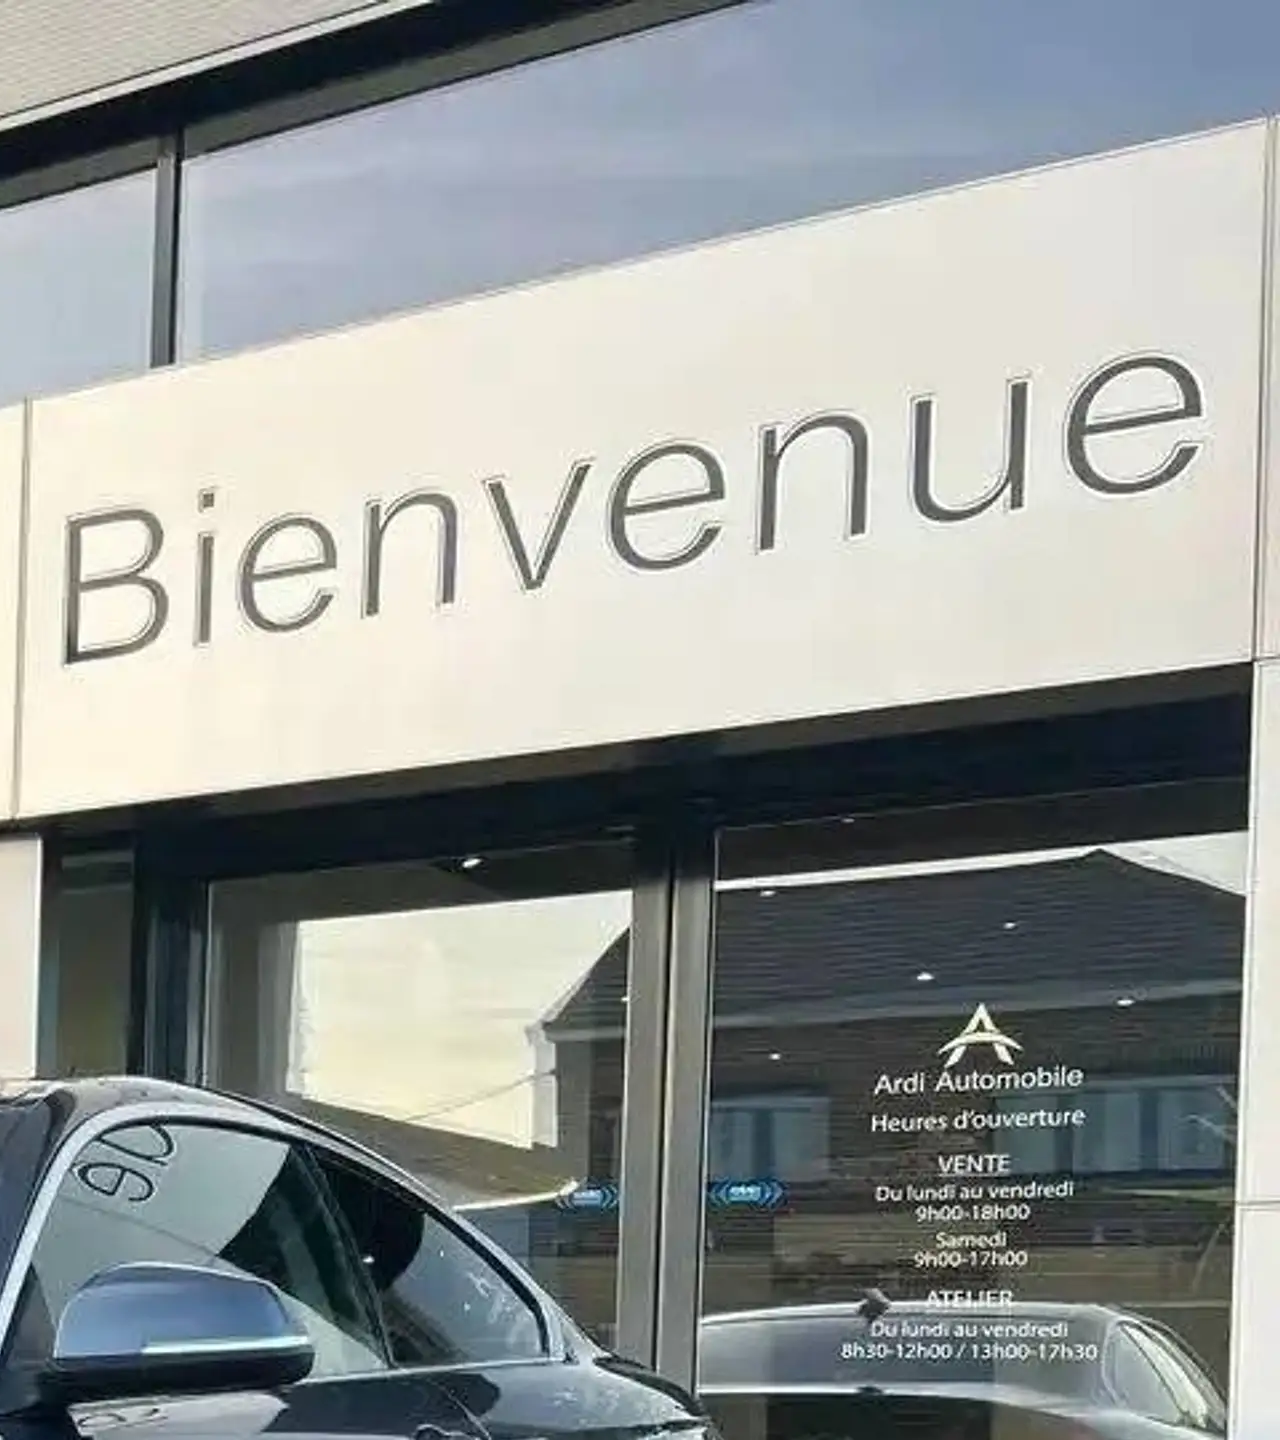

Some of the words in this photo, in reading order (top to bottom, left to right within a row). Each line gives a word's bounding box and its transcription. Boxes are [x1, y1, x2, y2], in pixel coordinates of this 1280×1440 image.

[62, 350, 1203, 664] Bienvenue
[874, 1072, 925, 1096] Ardi
[934, 1065, 1085, 1092] Automobile
[871, 1113, 947, 1132] Heures
[953, 1108, 1087, 1129] d'ouverture
[938, 1153, 1011, 1174] VENTE
[875, 1186, 903, 1201] Du
[906, 1183, 955, 1200] lundi
[959, 1186, 983, 1199] au
[988, 1181, 1074, 1198] vendredi
[915, 1204, 1031, 1221] 9h00-18h00
[935, 1231, 1007, 1248] Samedi
[914, 1250, 1028, 1268] 9h00-17h00
[926, 1289, 1013, 1308] ATELIER
[870, 1323, 896, 1338] Du
[901, 1321, 949, 1338] lundi
[953, 1324, 978, 1338] au
[981, 1320, 1069, 1338] vendredi
[841, 1343, 953, 1359] 8h30-12h00
[972, 1342, 1098, 1360] 13h00-17h30
